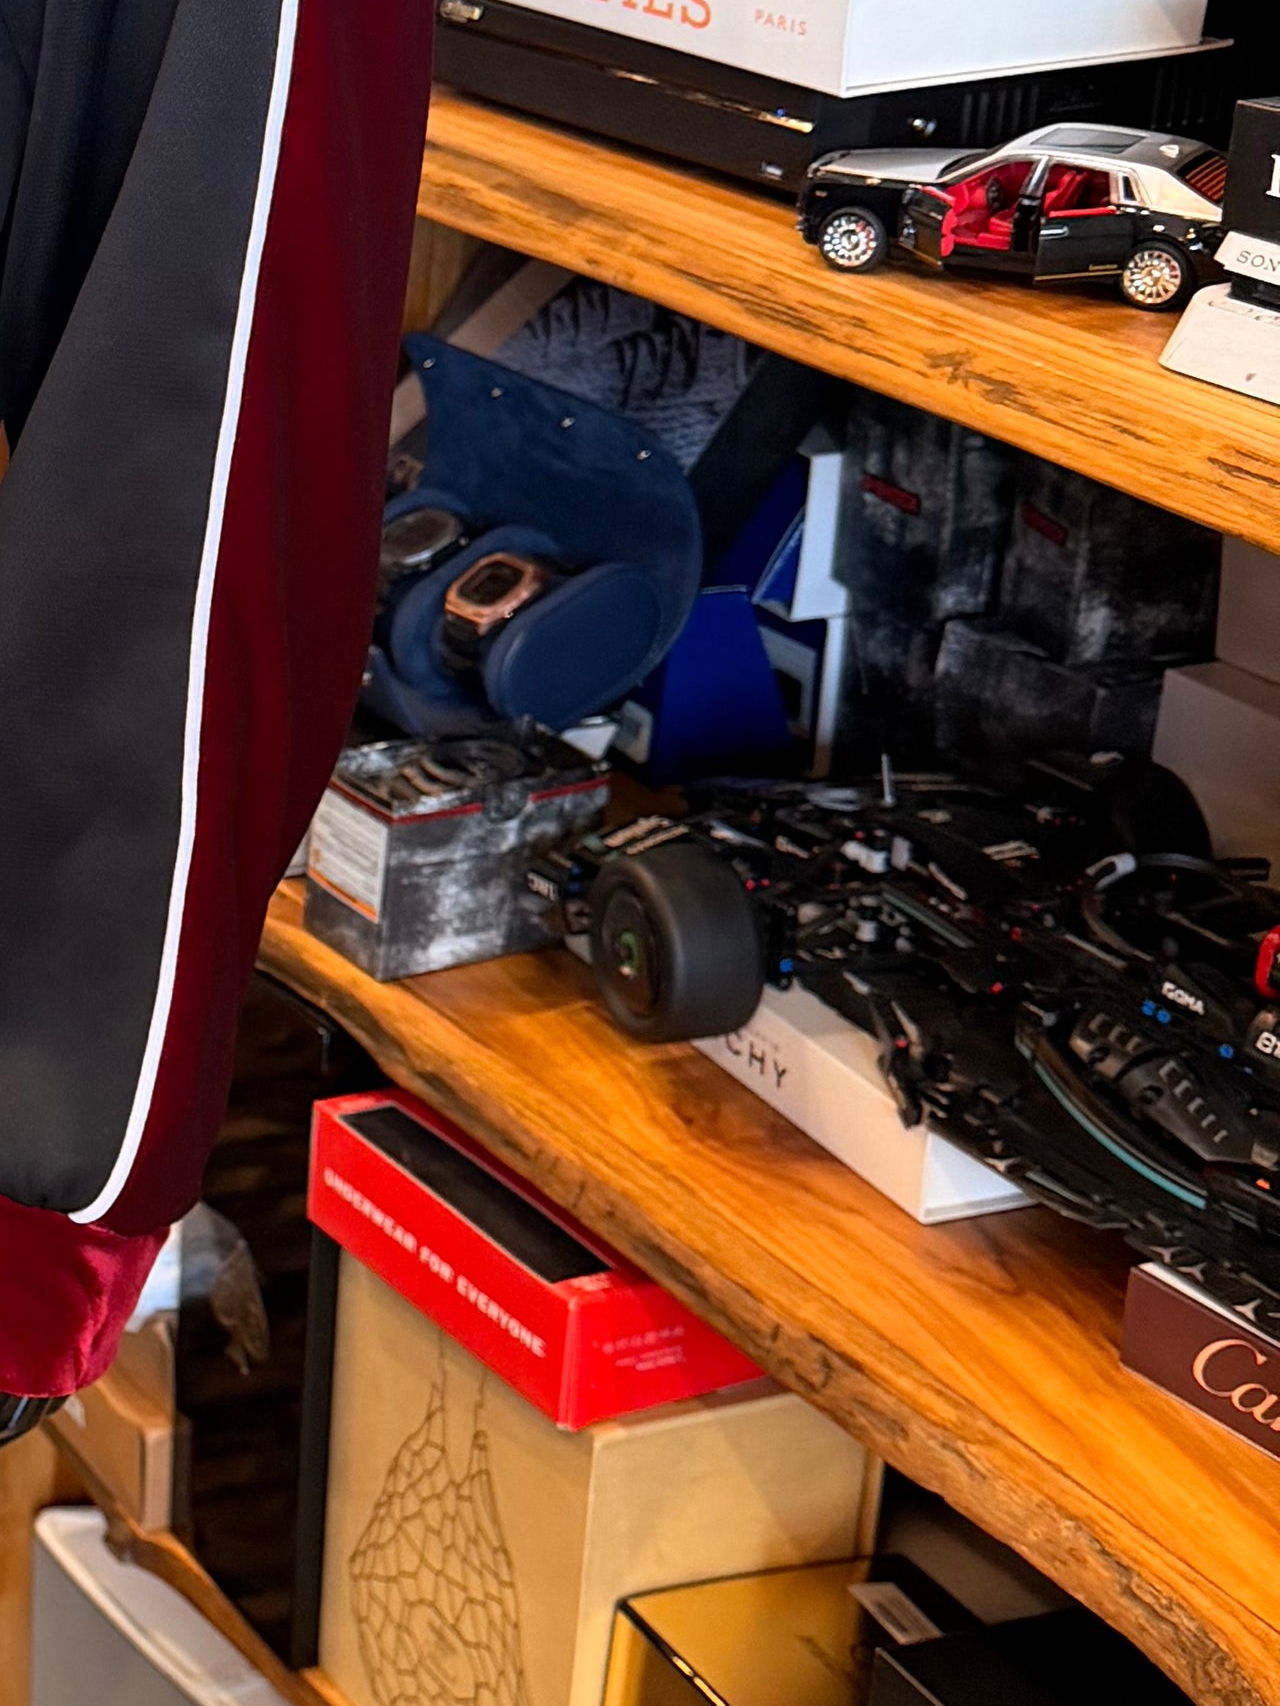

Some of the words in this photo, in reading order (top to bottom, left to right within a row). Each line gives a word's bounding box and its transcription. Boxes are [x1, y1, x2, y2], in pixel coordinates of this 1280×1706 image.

[753, 8, 808, 36] PARIS
[323, 1165, 418, 1254] UNDERWEAR
[419, 1245, 455, 1284] FOR
[456, 1274, 548, 1359] EVERYONE
[1192, 1338, 1280, 1432] Ca
